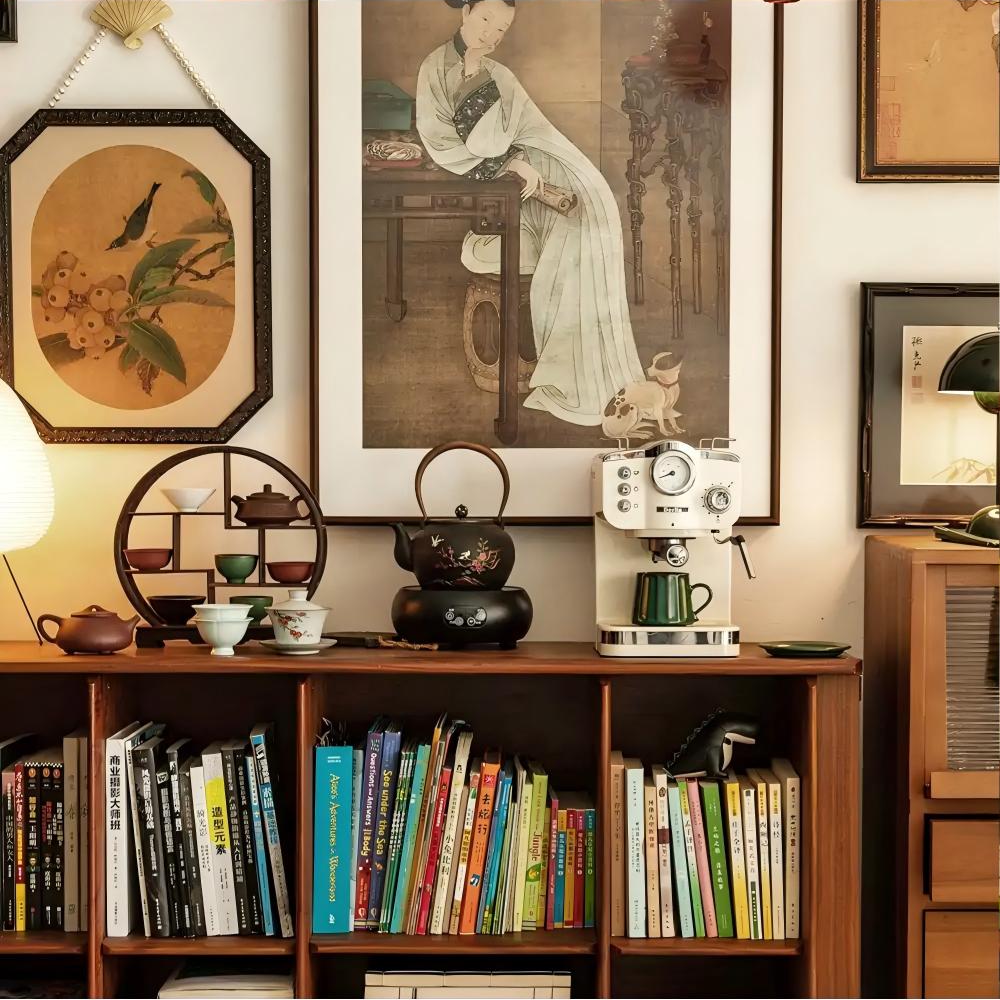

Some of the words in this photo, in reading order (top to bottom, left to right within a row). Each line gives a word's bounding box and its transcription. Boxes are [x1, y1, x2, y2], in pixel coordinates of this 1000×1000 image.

[369, 752, 379, 787] Questions
[382, 769, 393, 787] See
[109, 755, 121, 831] 商业摄影大师班
[379, 789, 392, 818] under
[364, 796, 373, 826] Answers
[477, 793, 491, 836] 去旅行
[210, 806, 230, 856] 造型元素
[377, 819, 386, 836] the
[360, 836, 371, 857] Body
[375, 837, 386, 856] Sea
[531, 831, 543, 862] Jungle
